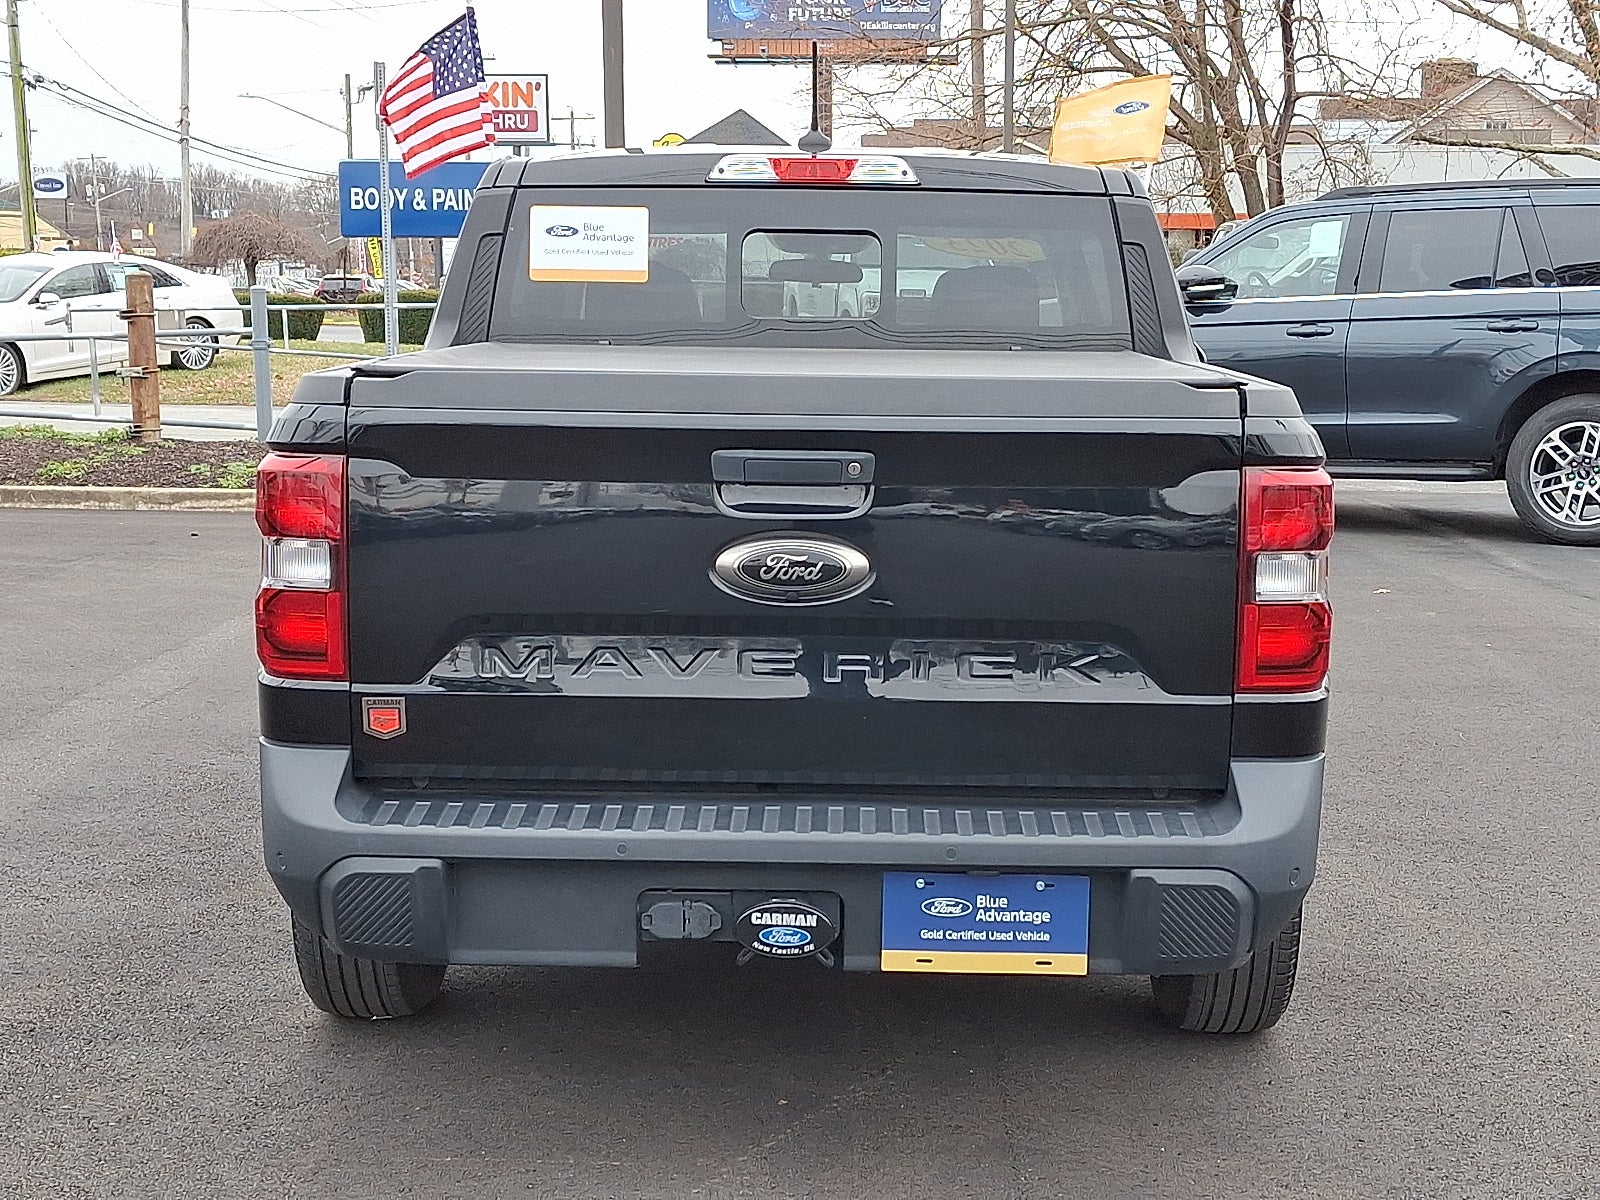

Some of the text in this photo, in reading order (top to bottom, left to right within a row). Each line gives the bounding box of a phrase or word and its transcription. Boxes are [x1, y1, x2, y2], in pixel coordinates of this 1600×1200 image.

[788, 7, 852, 22] FUTURE
[412, 187, 428, 211] &
[583, 222, 605, 231] Blue
[582, 233, 635, 243] Advantage
[759, 553, 824, 581] Ford
[479, 643, 1104, 684] MAVERICK
[930, 900, 963, 914] Ford
[975, 894, 1009, 908] Blue
[750, 912, 818, 927] CARMAN
[975, 908, 1051, 925] Advantage
[768, 928, 801, 943] Ford
[920, 929, 1050, 941] Gold Certified Used Vehicle
[751, 941, 771, 953] New
[803, 943, 816, 953] DE
